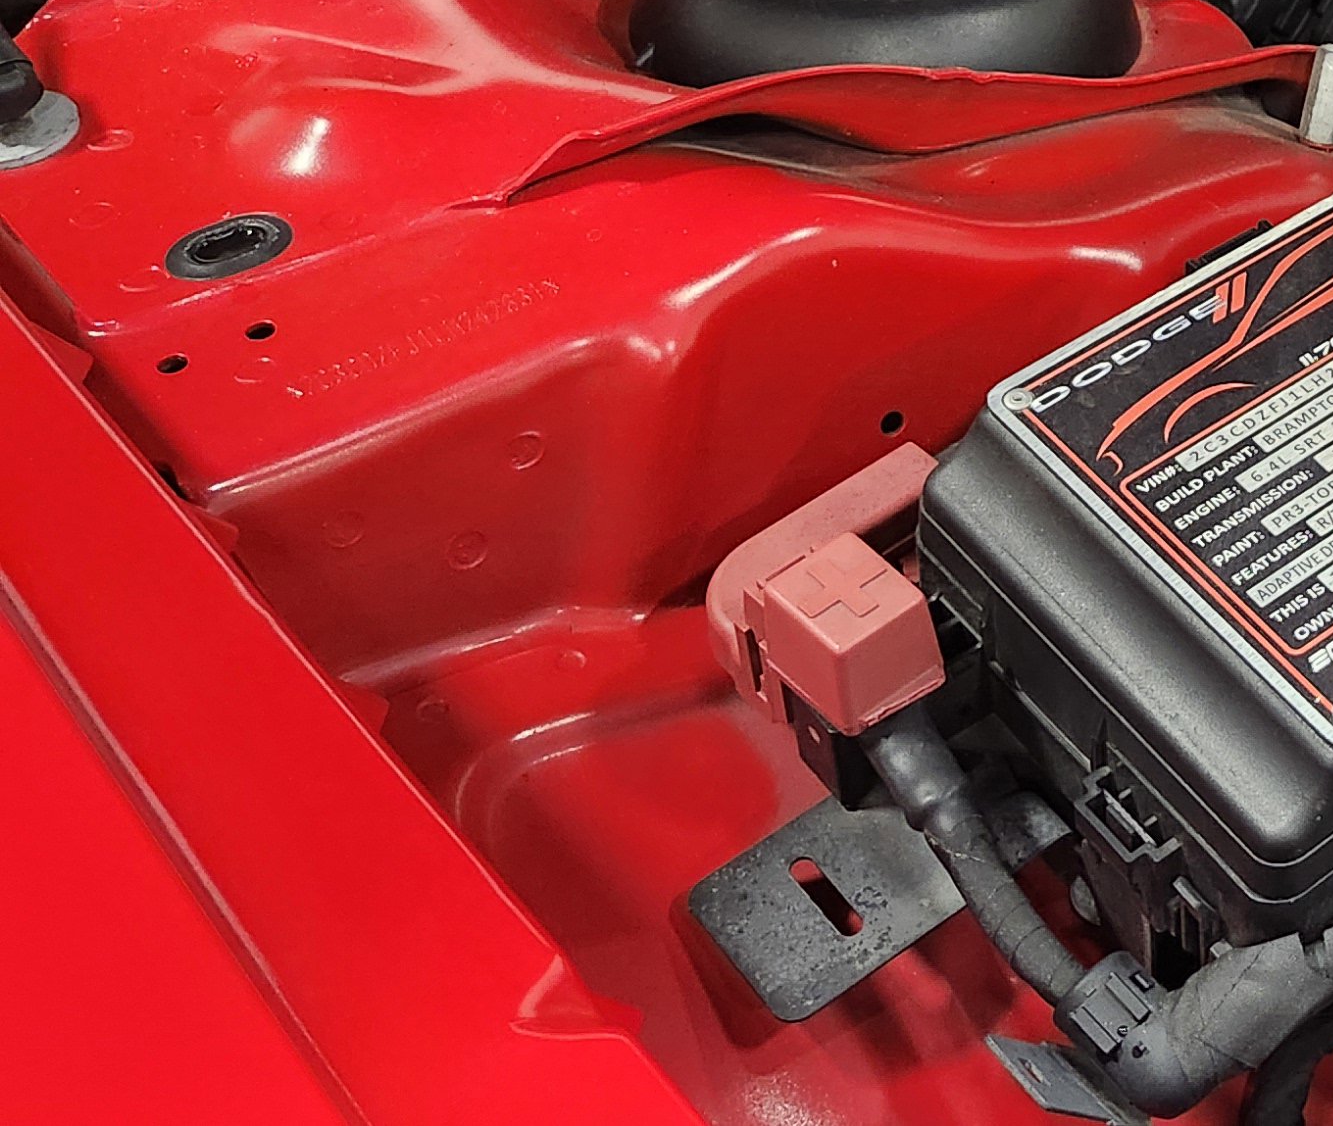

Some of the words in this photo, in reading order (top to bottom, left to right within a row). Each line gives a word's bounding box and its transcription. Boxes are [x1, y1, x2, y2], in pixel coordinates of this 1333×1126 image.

[1027, 294, 1228, 413] DODGE
[1134, 461, 1184, 495] VIN#:
[1153, 476, 1207, 513] BUILD
[1202, 443, 1260, 482] PLANT:
[1172, 483, 1242, 531] ENGINE:
[1248, 453, 1292, 483] 6.4L
[1291, 429, 1329, 455] SRT
[1190, 466, 1315, 549] TRANSMISSION:
[1210, 528, 1266, 568] PAINT:
[1230, 527, 1315, 586] FEATURES:
[1254, 552, 1322, 601] ADAPTIVE
[1269, 593, 1311, 624] THIS
[1305, 582, 1327, 599] IS
